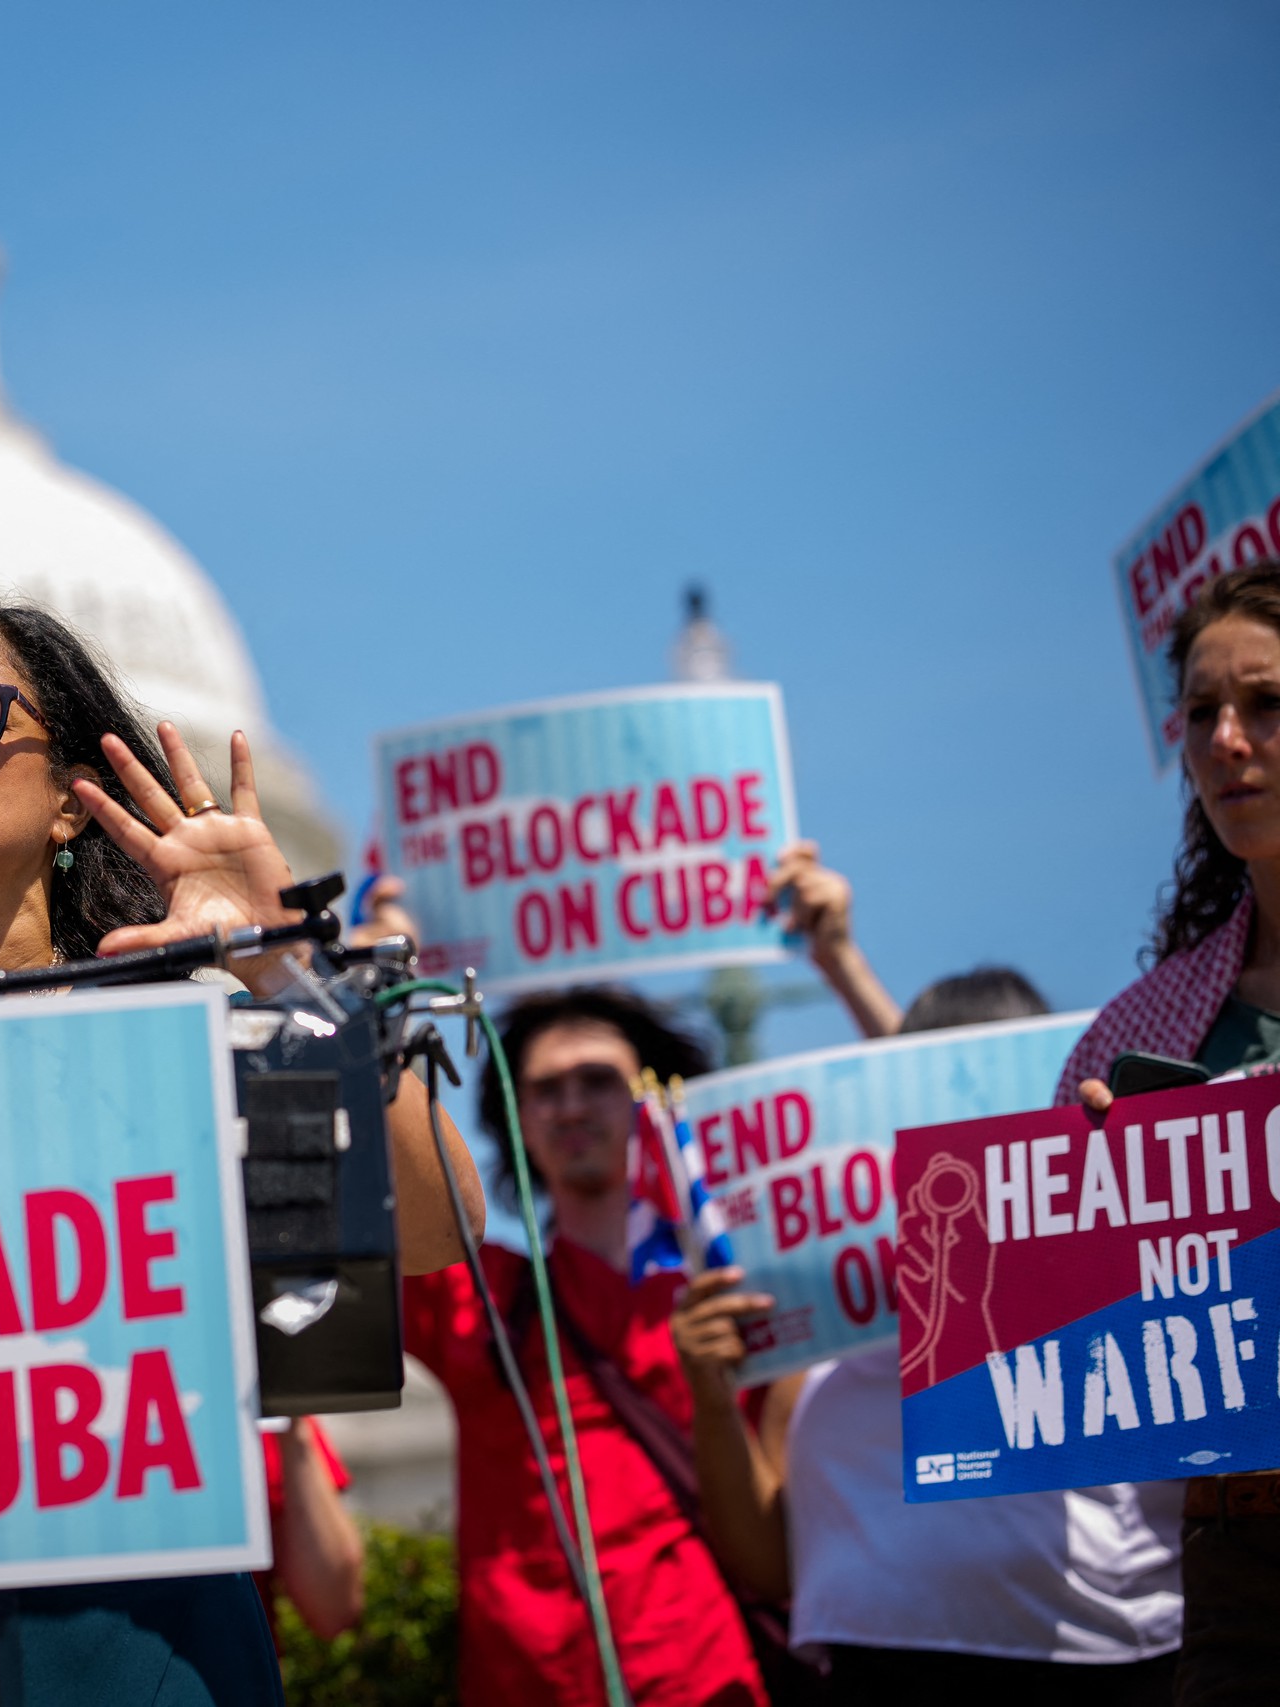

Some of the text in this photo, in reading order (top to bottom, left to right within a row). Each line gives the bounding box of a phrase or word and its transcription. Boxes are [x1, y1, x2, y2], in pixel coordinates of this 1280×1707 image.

[1131, 506, 1206, 617] END
[397, 743, 500, 823] END
[460, 773, 767, 888] BLOCKADE
[516, 882, 600, 959] ON
[617, 855, 775, 940] CUBA
[696, 1090, 814, 1188] END
[985, 1111, 1251, 1244] HEALTH
[769, 1148, 898, 1253] BLO
[1138, 1229, 1238, 1301] NOT
[987, 1298, 1280, 1450] WARF
[956, 1448, 1000, 1461] National
